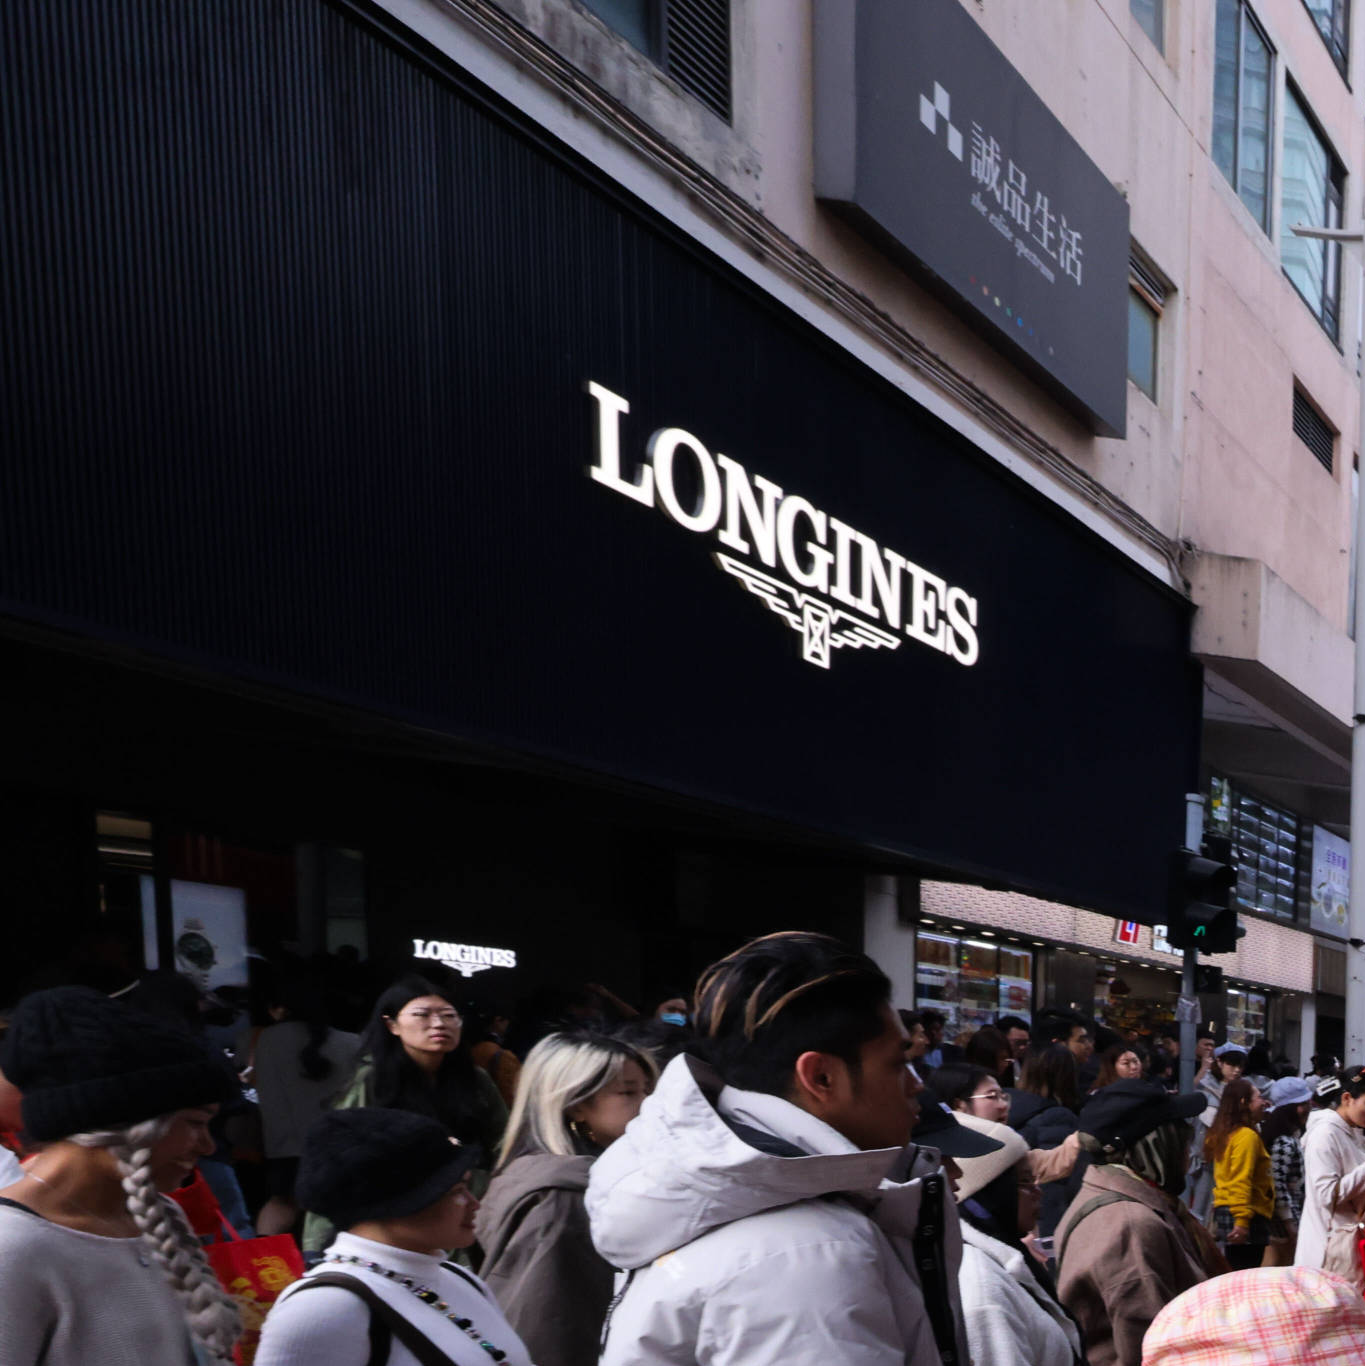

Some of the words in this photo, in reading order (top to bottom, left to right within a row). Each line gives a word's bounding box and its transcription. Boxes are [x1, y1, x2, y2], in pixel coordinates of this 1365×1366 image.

[971, 120, 1083, 286] 誠品生活
[589, 381, 981, 667] LONGINES
[413, 939, 517, 969] LONGINES
